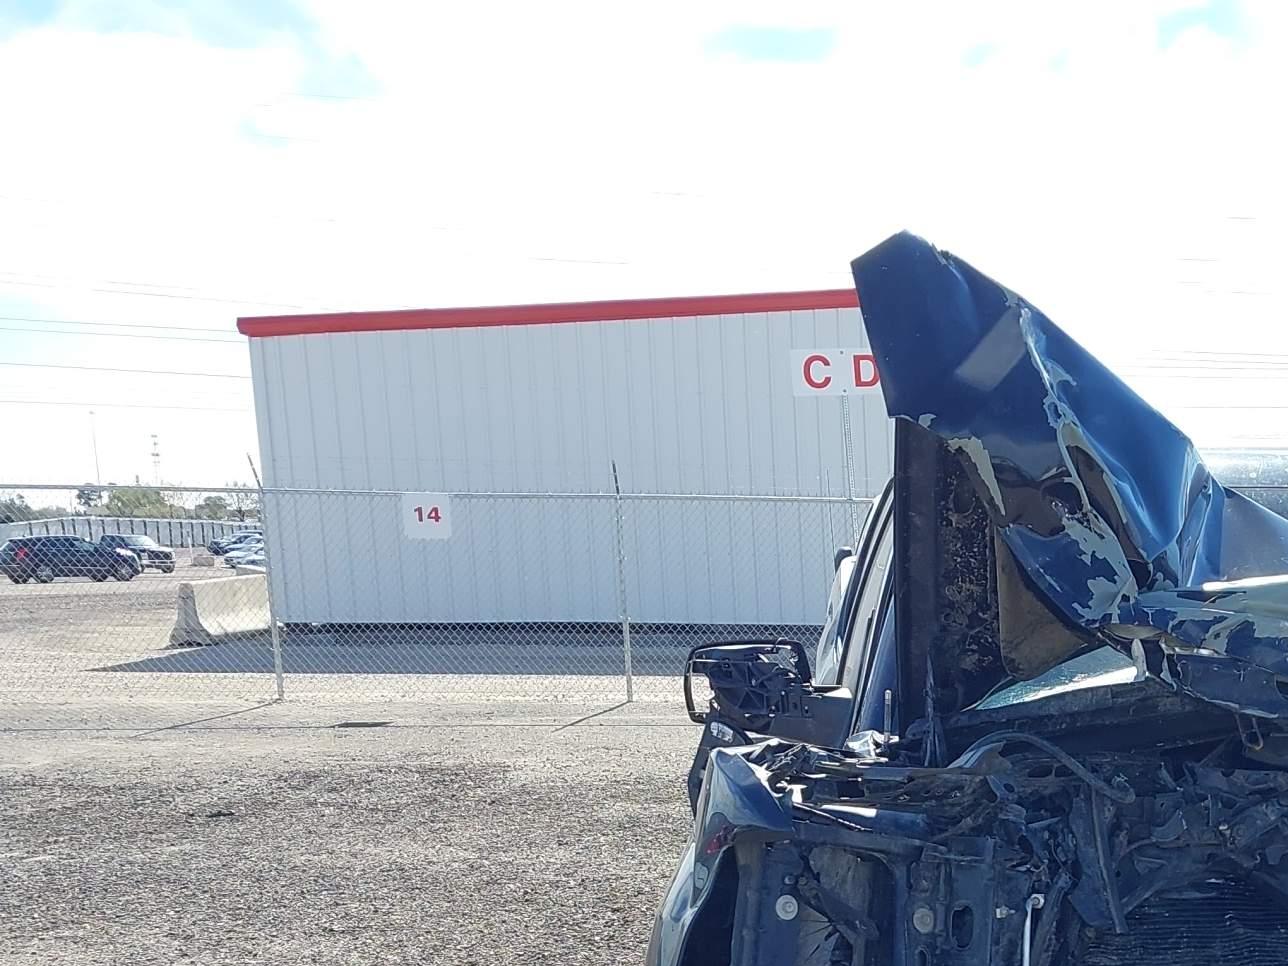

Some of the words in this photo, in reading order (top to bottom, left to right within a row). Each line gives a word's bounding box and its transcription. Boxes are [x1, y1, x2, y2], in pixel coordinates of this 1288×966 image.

[803, 354, 832, 389] C
[853, 354, 881, 387] D
[413, 506, 442, 523] 14
